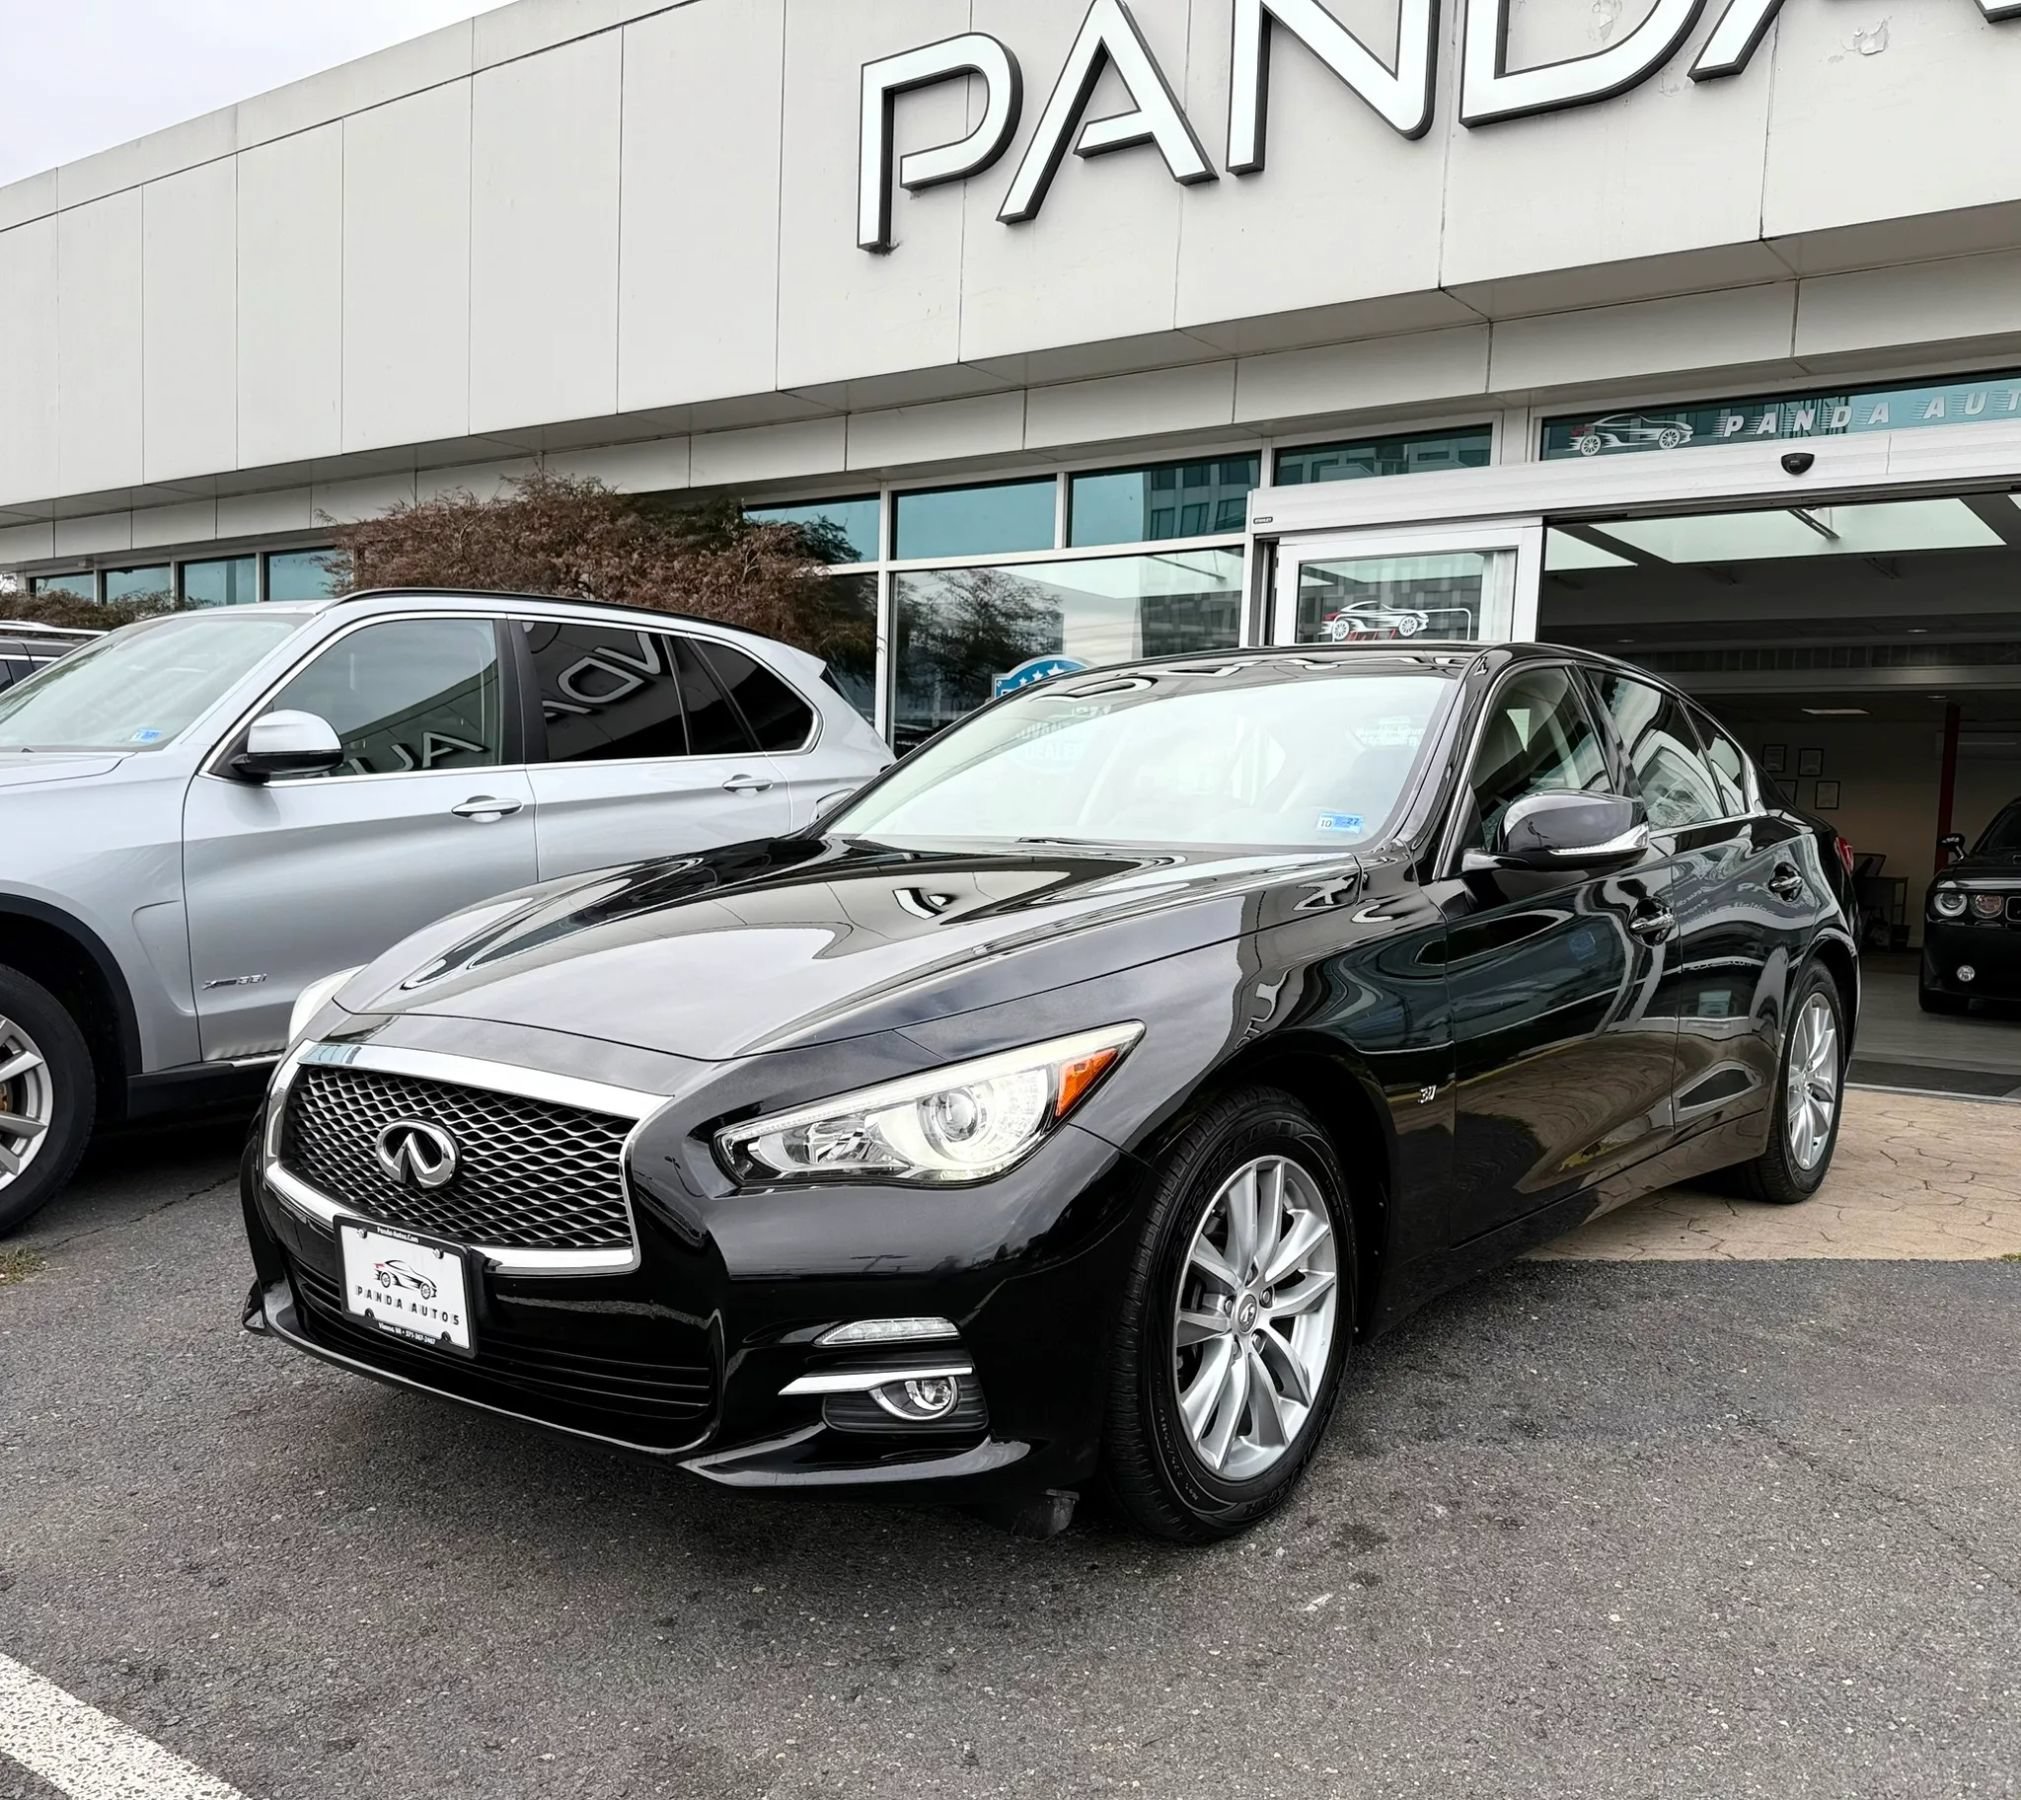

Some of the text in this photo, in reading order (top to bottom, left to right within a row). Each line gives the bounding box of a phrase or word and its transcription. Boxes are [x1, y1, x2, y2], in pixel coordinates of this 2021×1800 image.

[1714, 403, 1891, 438] PANDA
[355, 1286, 459, 1325] PANDA AUTOS
